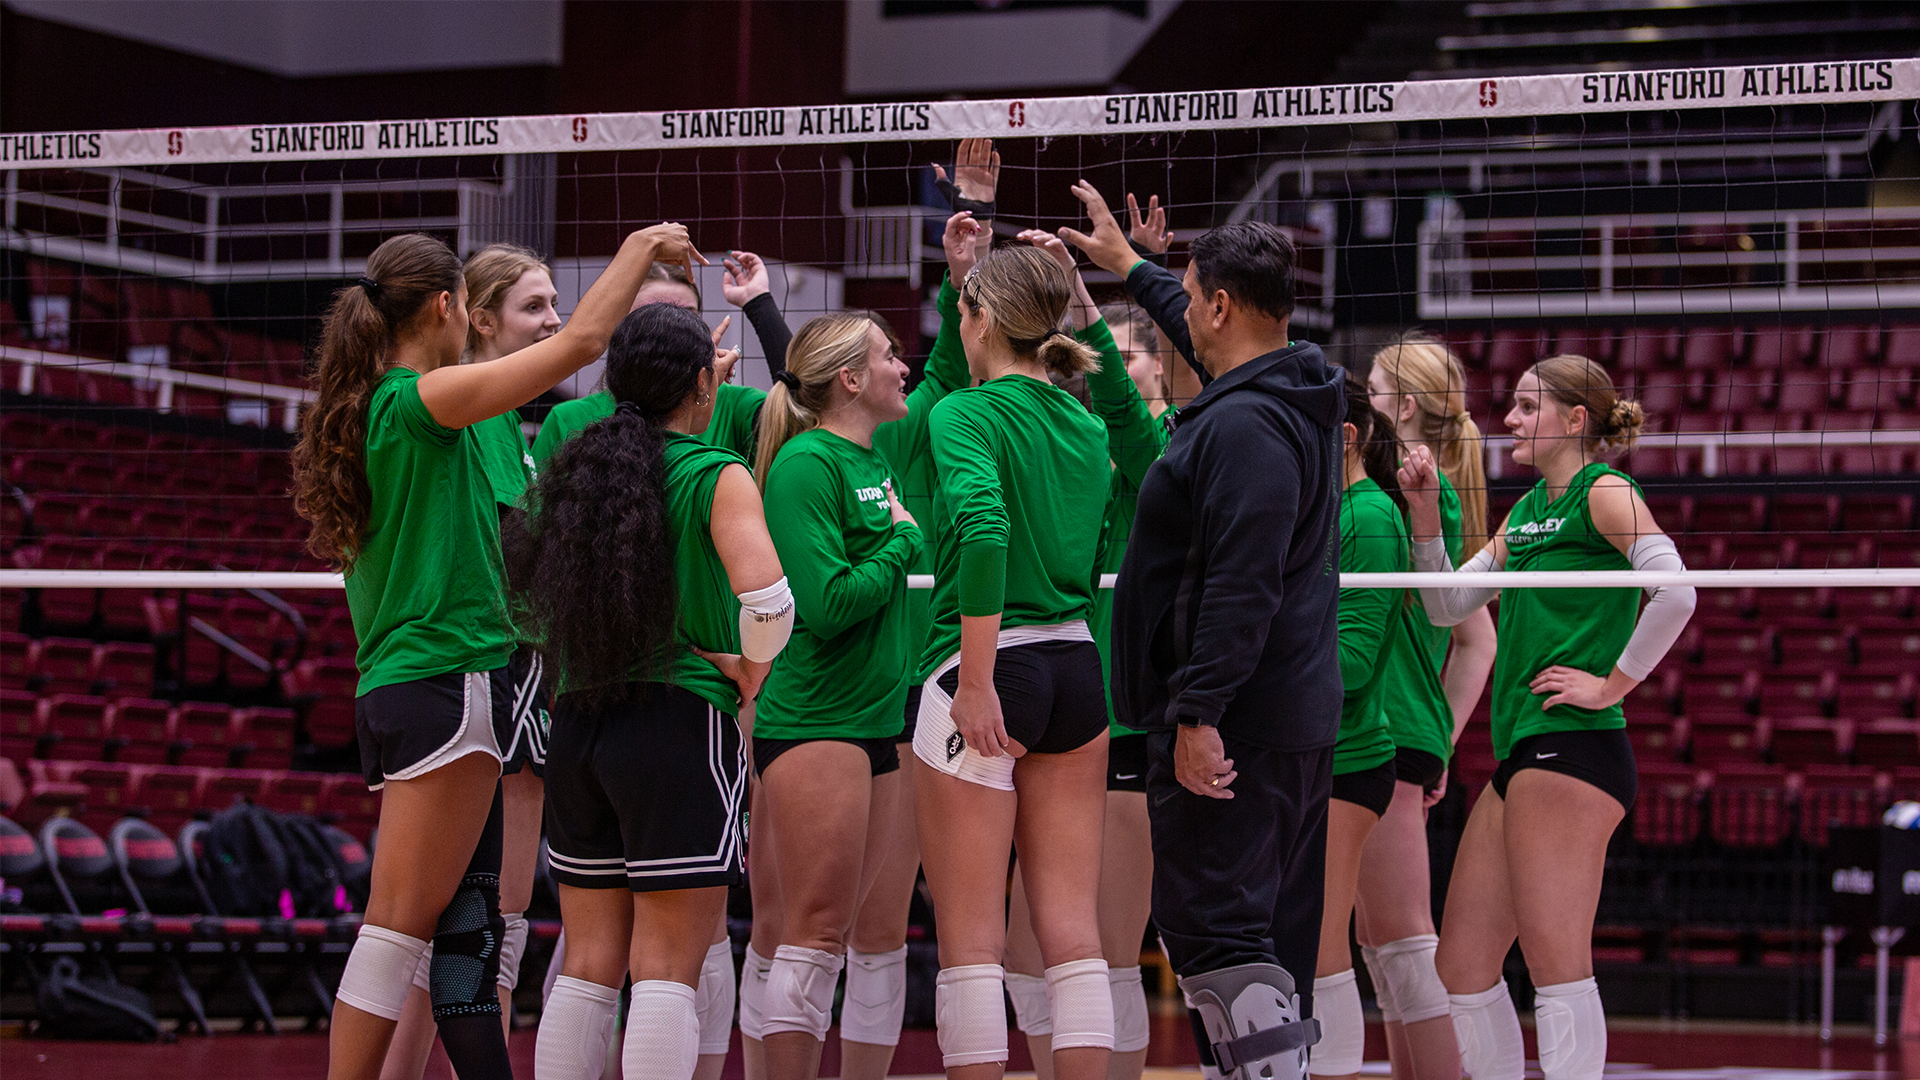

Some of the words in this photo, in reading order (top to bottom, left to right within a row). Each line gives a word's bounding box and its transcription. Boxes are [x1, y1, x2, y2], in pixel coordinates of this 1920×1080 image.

[1583, 70, 1725, 104] STANFORD
[1741, 61, 1893, 98] ATHLETICS
[661, 109, 785, 140] STANFORD
[798, 104, 930, 136] ATHLETICS
[1105, 92, 1238, 125] STANFORD
[1252, 84, 1395, 119] ATHLETICS
[0, 133, 101, 162] THLETICS
[250, 124, 365, 154] STANFORD
[377, 119, 499, 150] ATHLETICS
[855, 487, 884, 502] UTAH
